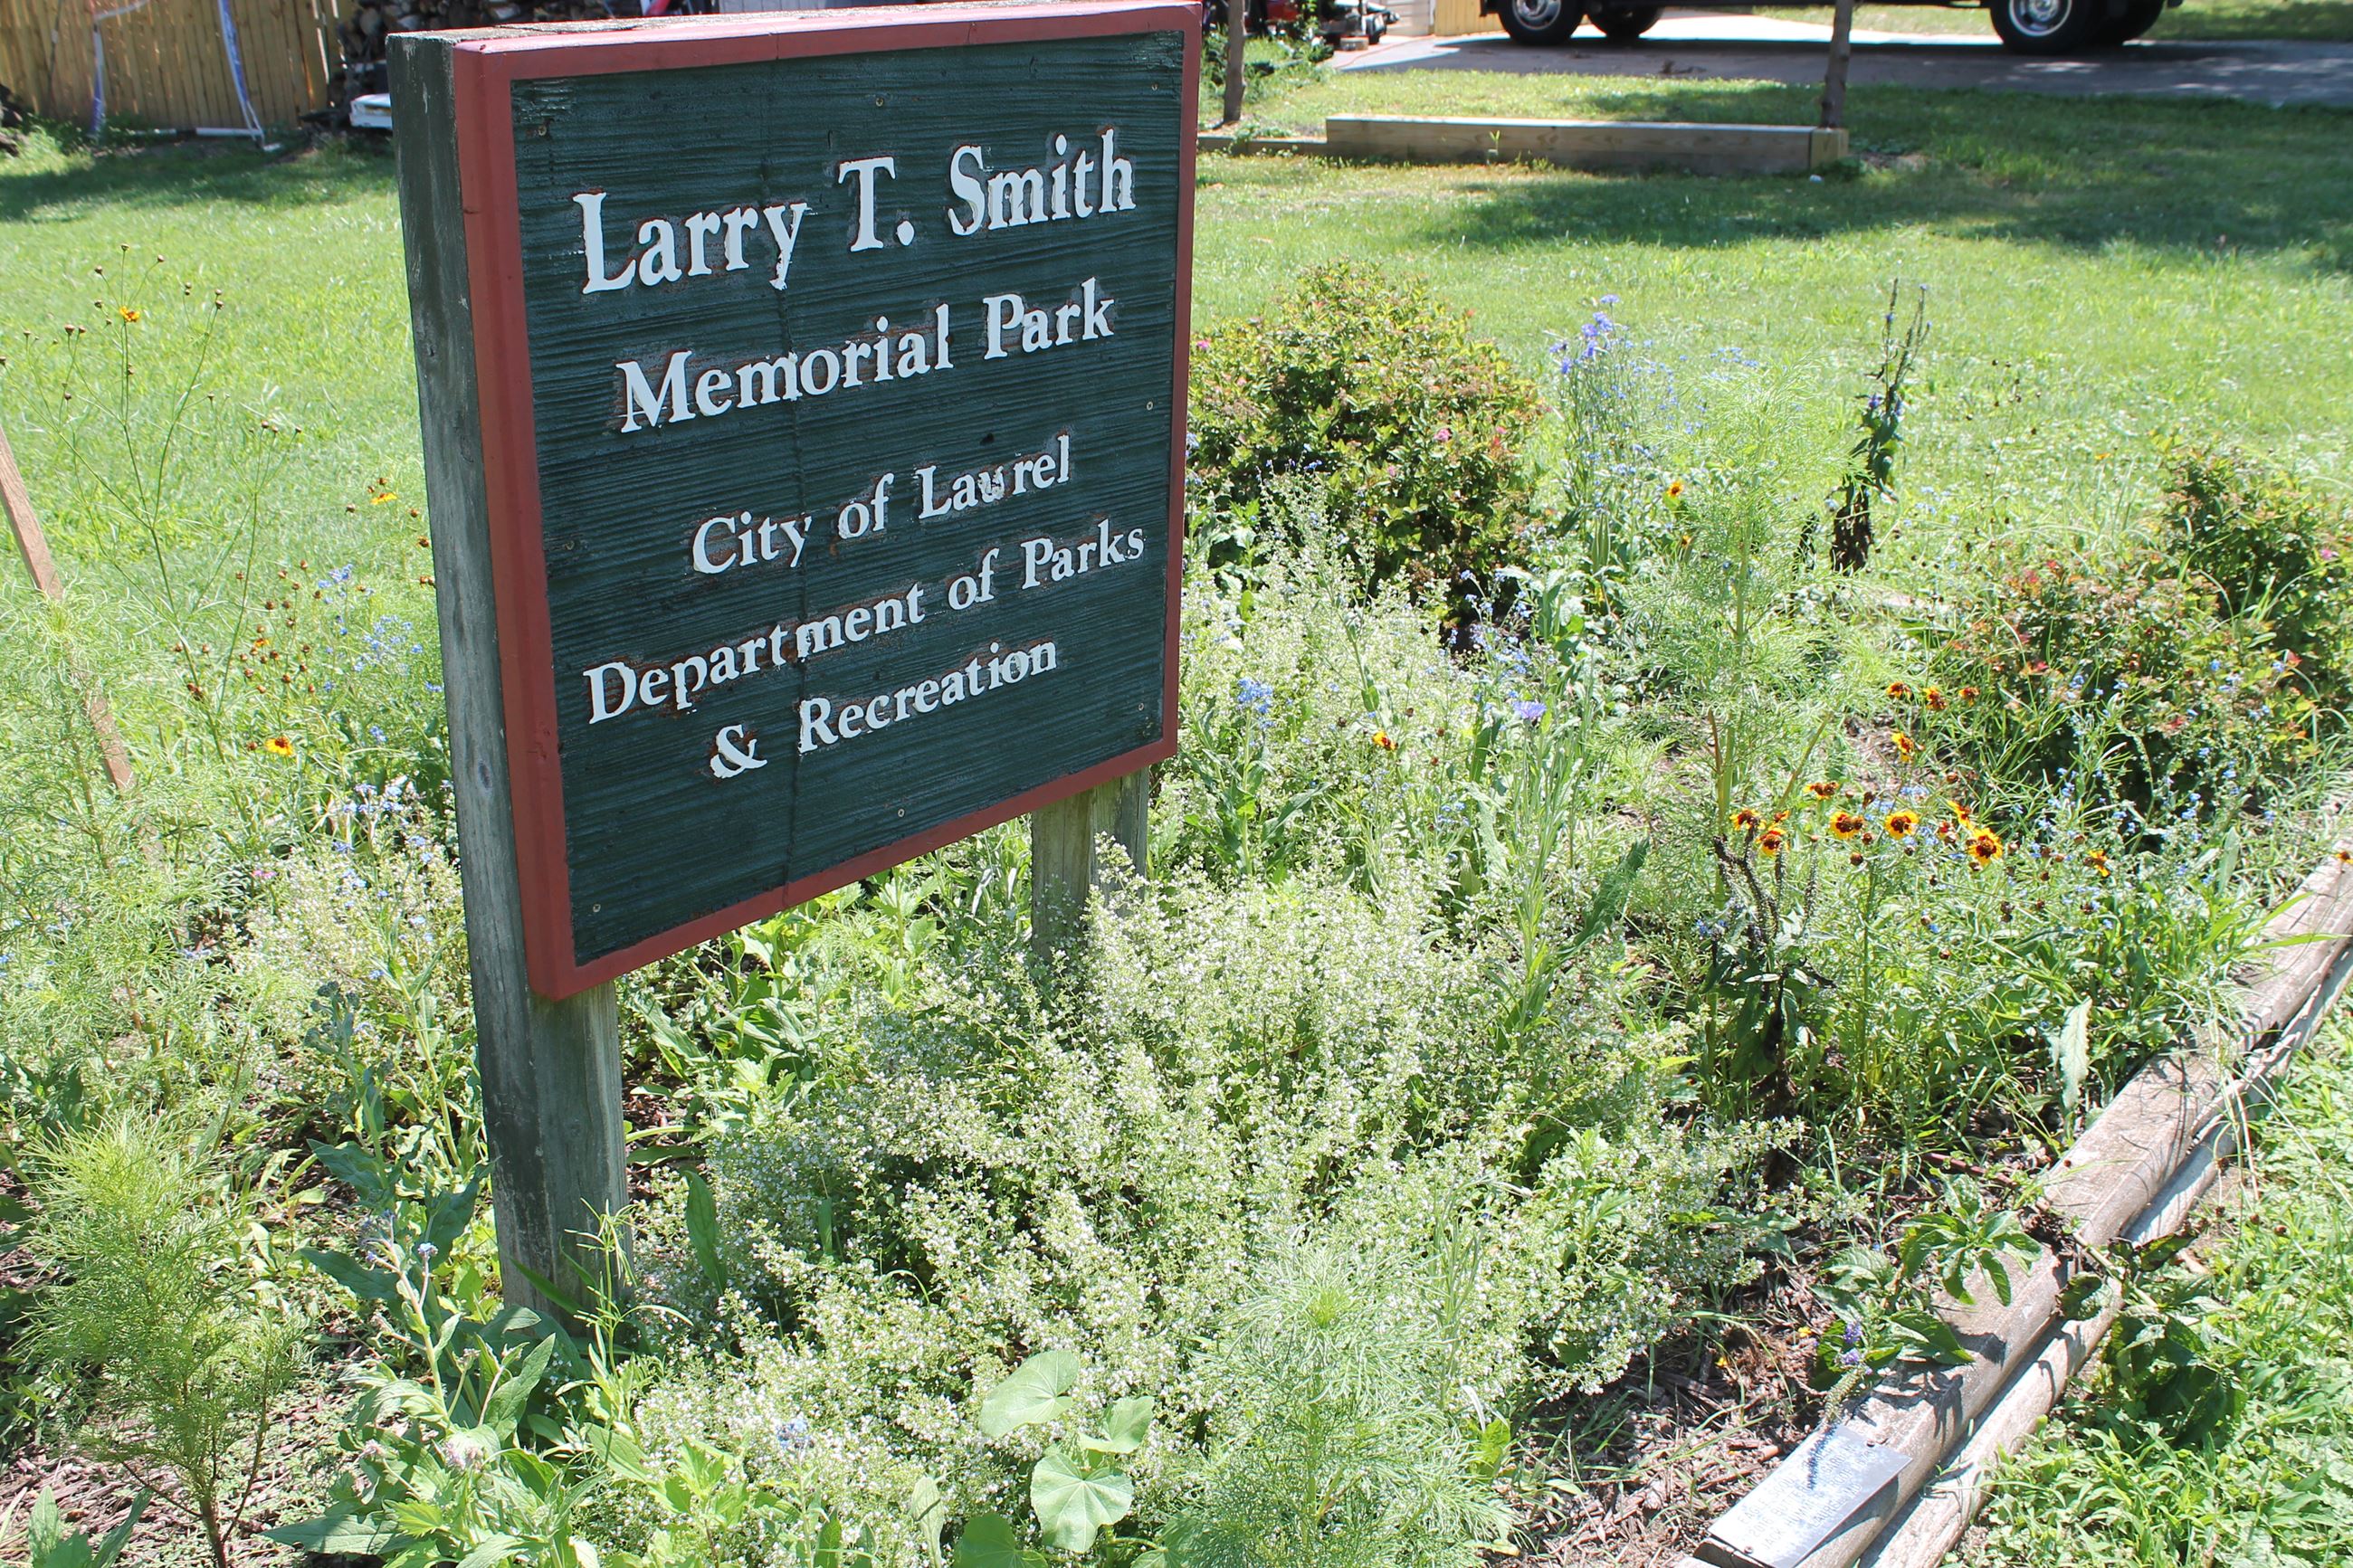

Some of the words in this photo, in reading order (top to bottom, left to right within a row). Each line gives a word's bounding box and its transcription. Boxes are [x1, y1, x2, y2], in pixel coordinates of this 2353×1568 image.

[573, 193, 812, 293] Larry
[839, 157, 914, 251] T.
[948, 129, 1136, 234] Smith
[616, 304, 953, 432] Memorial
[983, 277, 1114, 359] Park
[693, 511, 812, 573] City
[838, 473, 894, 538] of
[915, 435, 1069, 518] Laurel
[583, 584, 927, 728] Department
[948, 548, 999, 609] of
[1021, 519, 1143, 589] Parks
[710, 725, 767, 778] &
[795, 633, 1056, 753] Recreation
[1737, 1497, 1770, 1525] EAGLE
[1801, 1442, 1838, 1470] PRJEC
[1748, 1517, 1774, 1537] 2016
[1770, 1475, 1826, 1517] BUTTER
[1821, 1445, 1856, 1474] GARDEN
[1760, 1528, 1783, 1550] JACK
